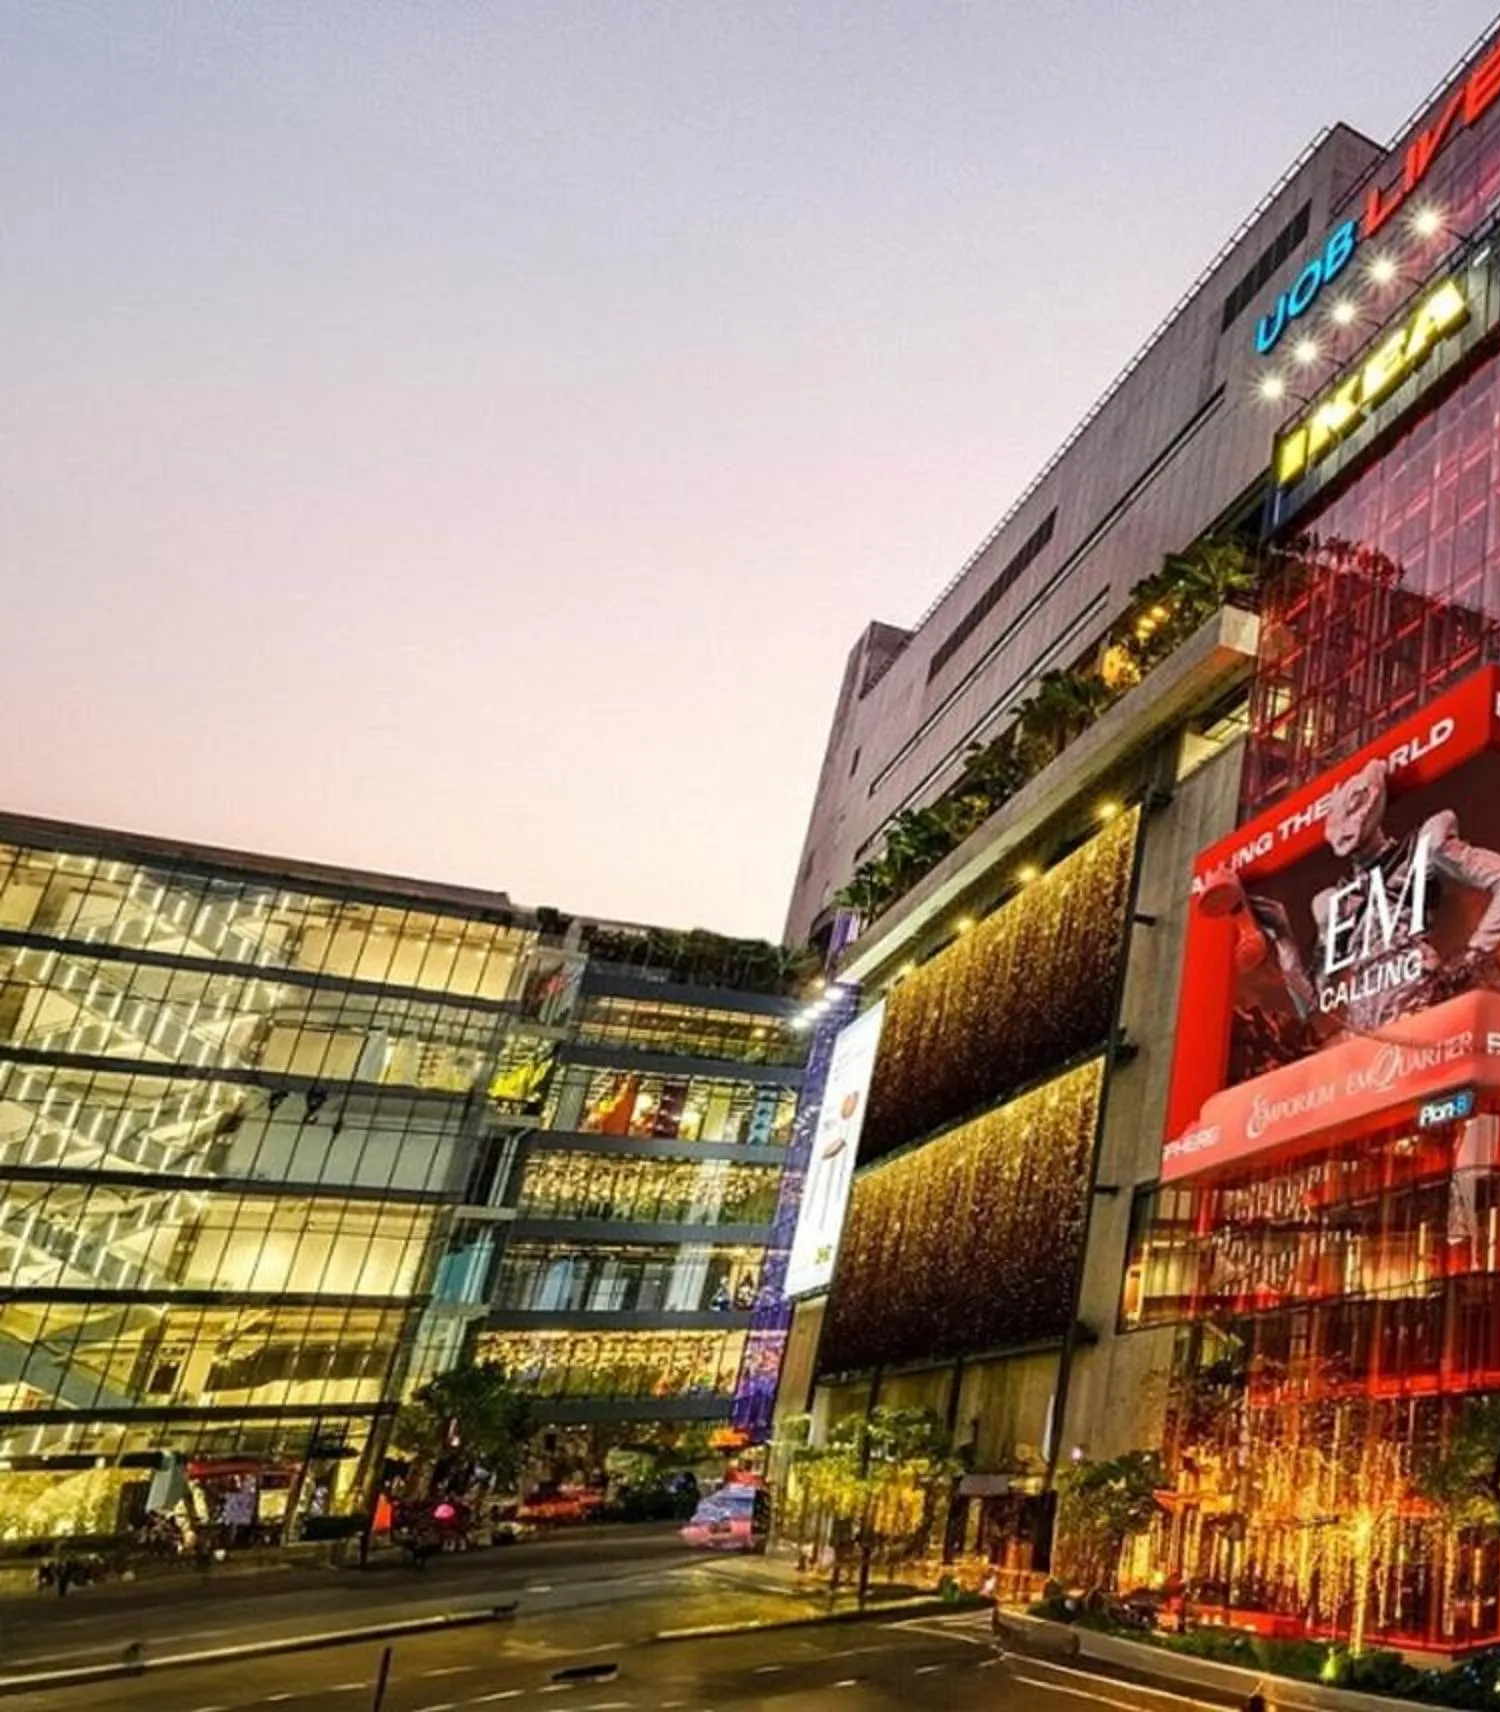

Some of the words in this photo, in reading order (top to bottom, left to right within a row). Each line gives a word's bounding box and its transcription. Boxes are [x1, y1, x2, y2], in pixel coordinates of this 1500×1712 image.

[1254, 219, 1358, 355] UOB
[1277, 277, 1469, 486] IKEA
[1323, 834, 1429, 976] EM
[1319, 949, 1423, 1013] CALLING
